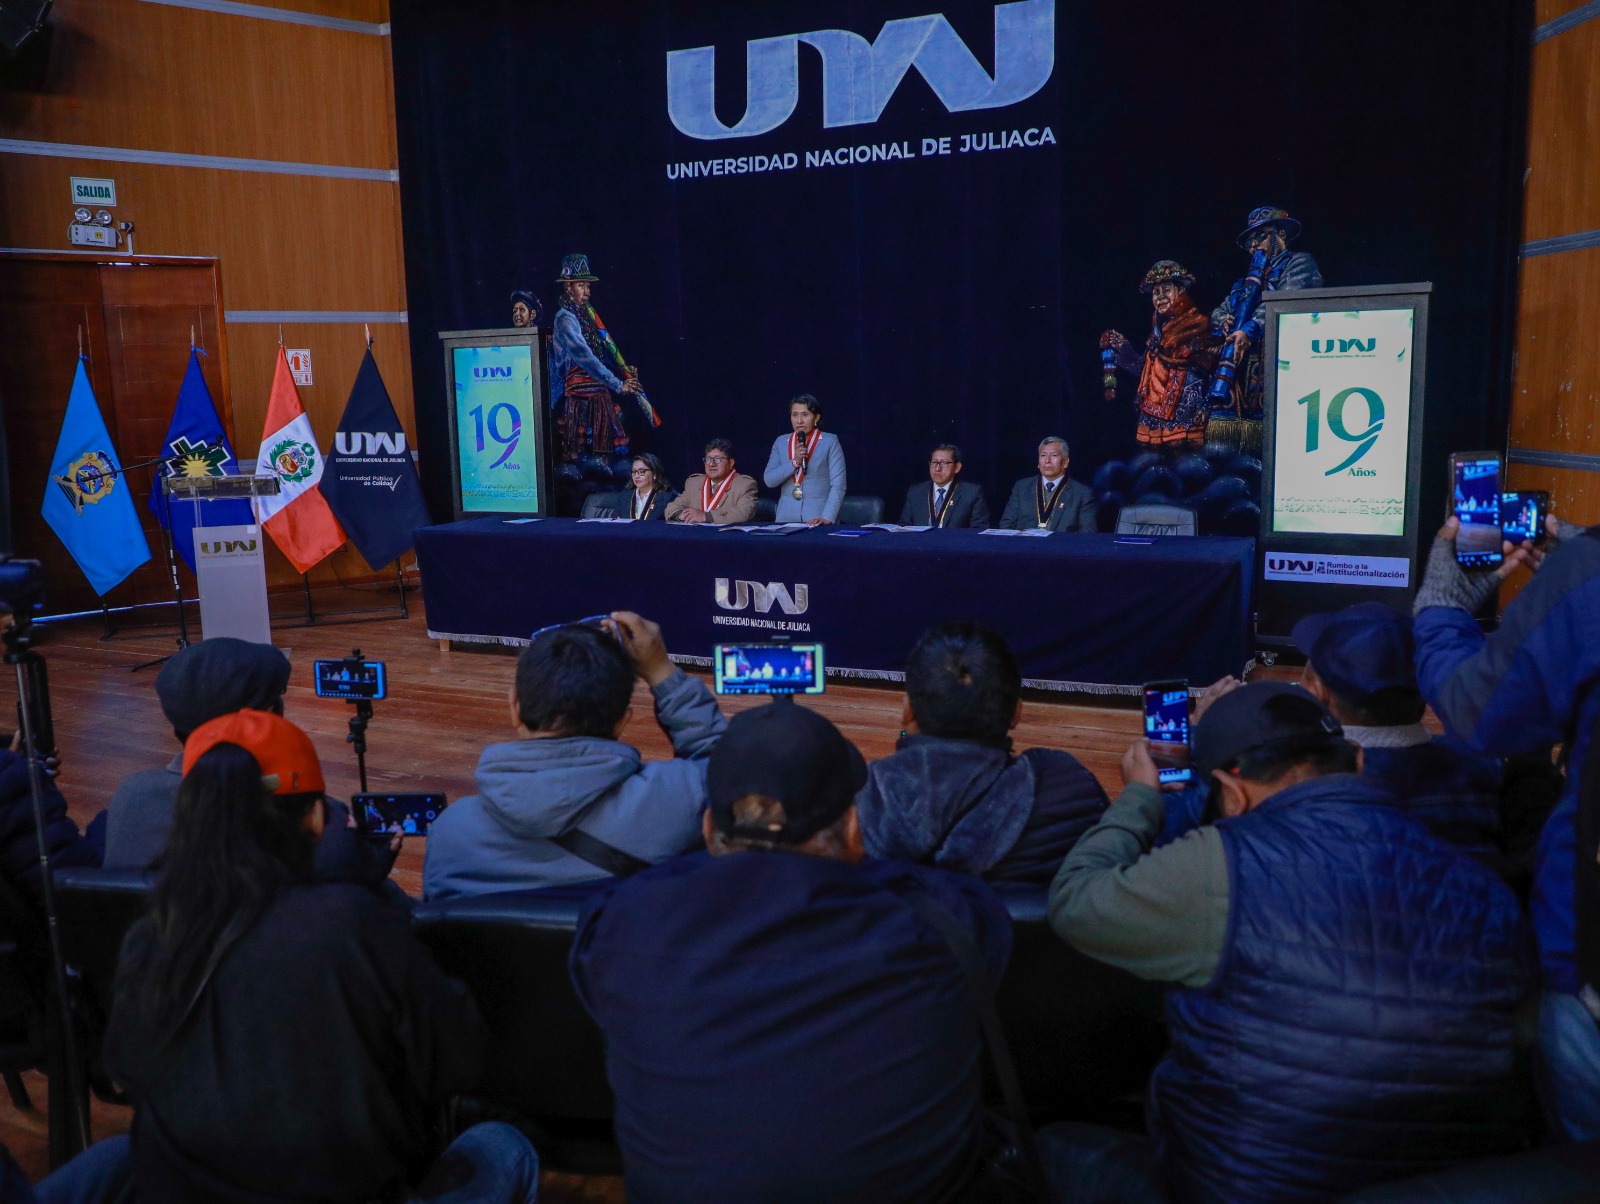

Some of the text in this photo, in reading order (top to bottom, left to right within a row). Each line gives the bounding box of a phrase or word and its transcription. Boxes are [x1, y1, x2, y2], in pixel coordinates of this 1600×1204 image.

[666, 126, 1057, 180] UNIVERSIDAD NACIONAL DE JULIACA
[77, 185, 111, 198] SALIDA
[468, 402, 521, 470] 19
[1297, 387, 1385, 477] 19
[503, 462, 520, 470] Años
[1348, 467, 1377, 477] Años
[1326, 562, 1353, 570] Rumbo
[1326, 569, 1405, 579] Institucionalización
[712, 615, 811, 632] UNIVERSIDAD NACIONAL DE JULIACA
